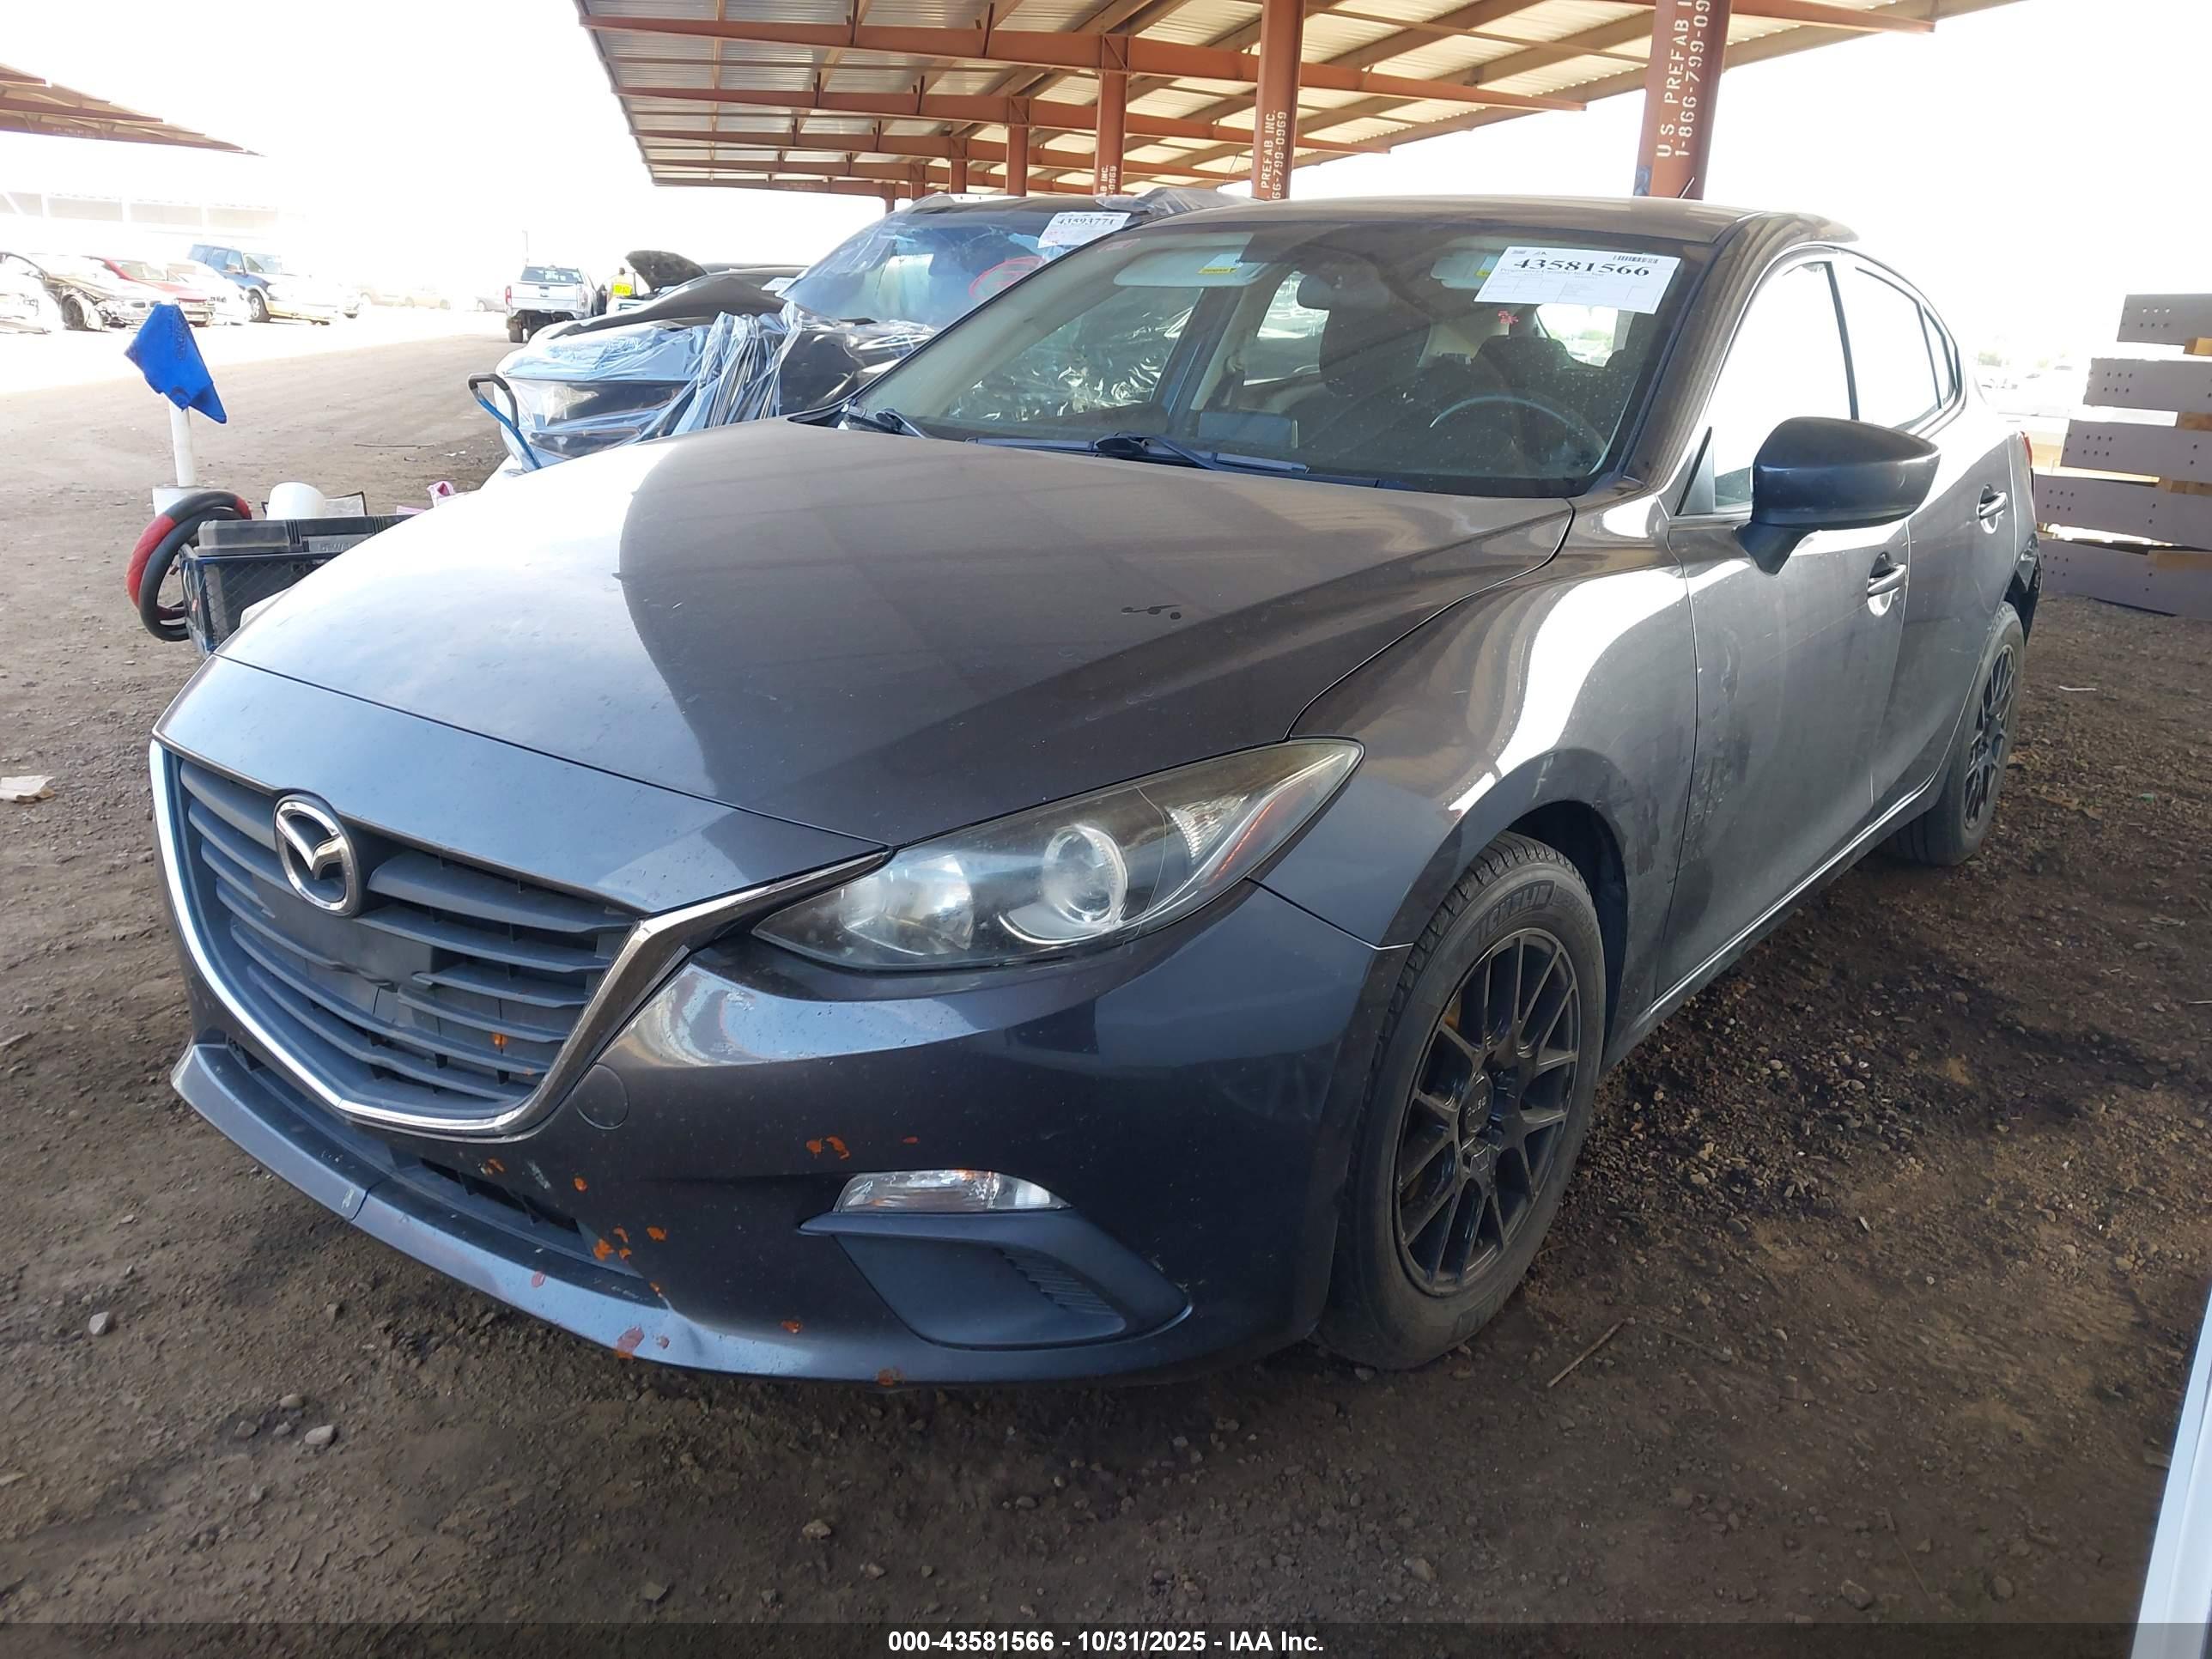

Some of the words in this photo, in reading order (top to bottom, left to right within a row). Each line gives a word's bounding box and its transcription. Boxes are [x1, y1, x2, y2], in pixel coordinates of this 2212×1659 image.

[1664, 19, 1689, 103] PREFAB
[1265, 110, 1276, 134] INC.
[1656, 118, 1676, 157] U.S.
[1261, 140, 1273, 189] PREFAB
[1514, 258, 1650, 276] 43581566
